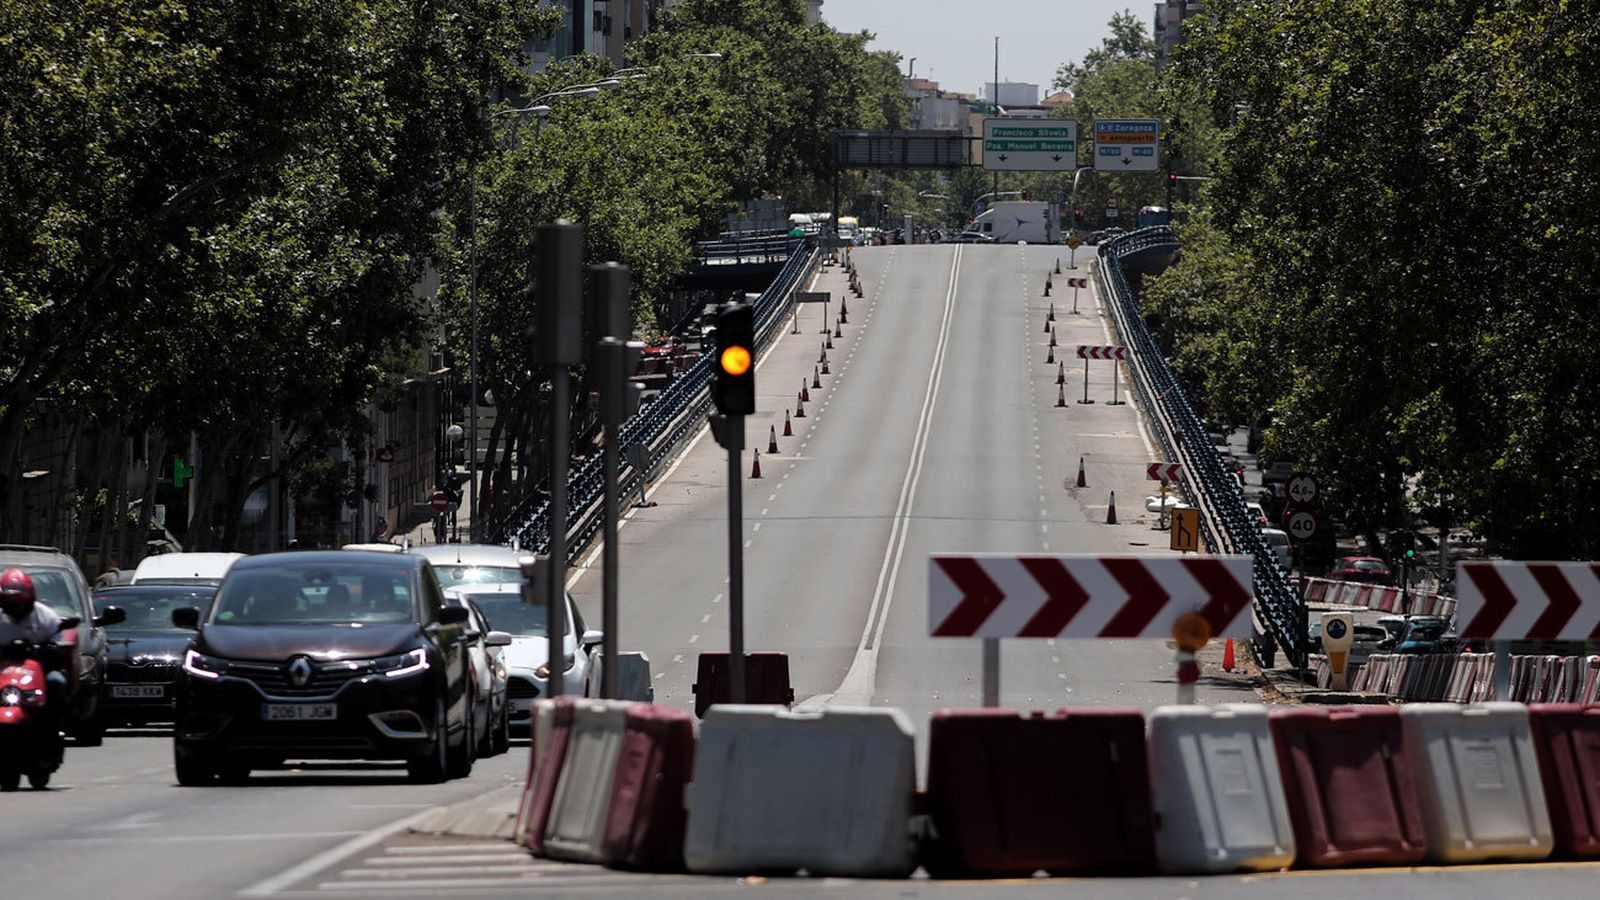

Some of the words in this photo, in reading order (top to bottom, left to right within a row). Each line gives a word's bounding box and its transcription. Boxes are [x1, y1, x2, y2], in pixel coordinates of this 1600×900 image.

[993, 128, 1034, 136] Francisco
[1038, 128, 1067, 136] Silvela
[1115, 124, 1153, 132] Zaragoza
[1007, 142, 1037, 150] Manuel
[1041, 142, 1073, 150] Becerra
[1292, 519, 1313, 531] 40
[271, 706, 303, 718] 2061
